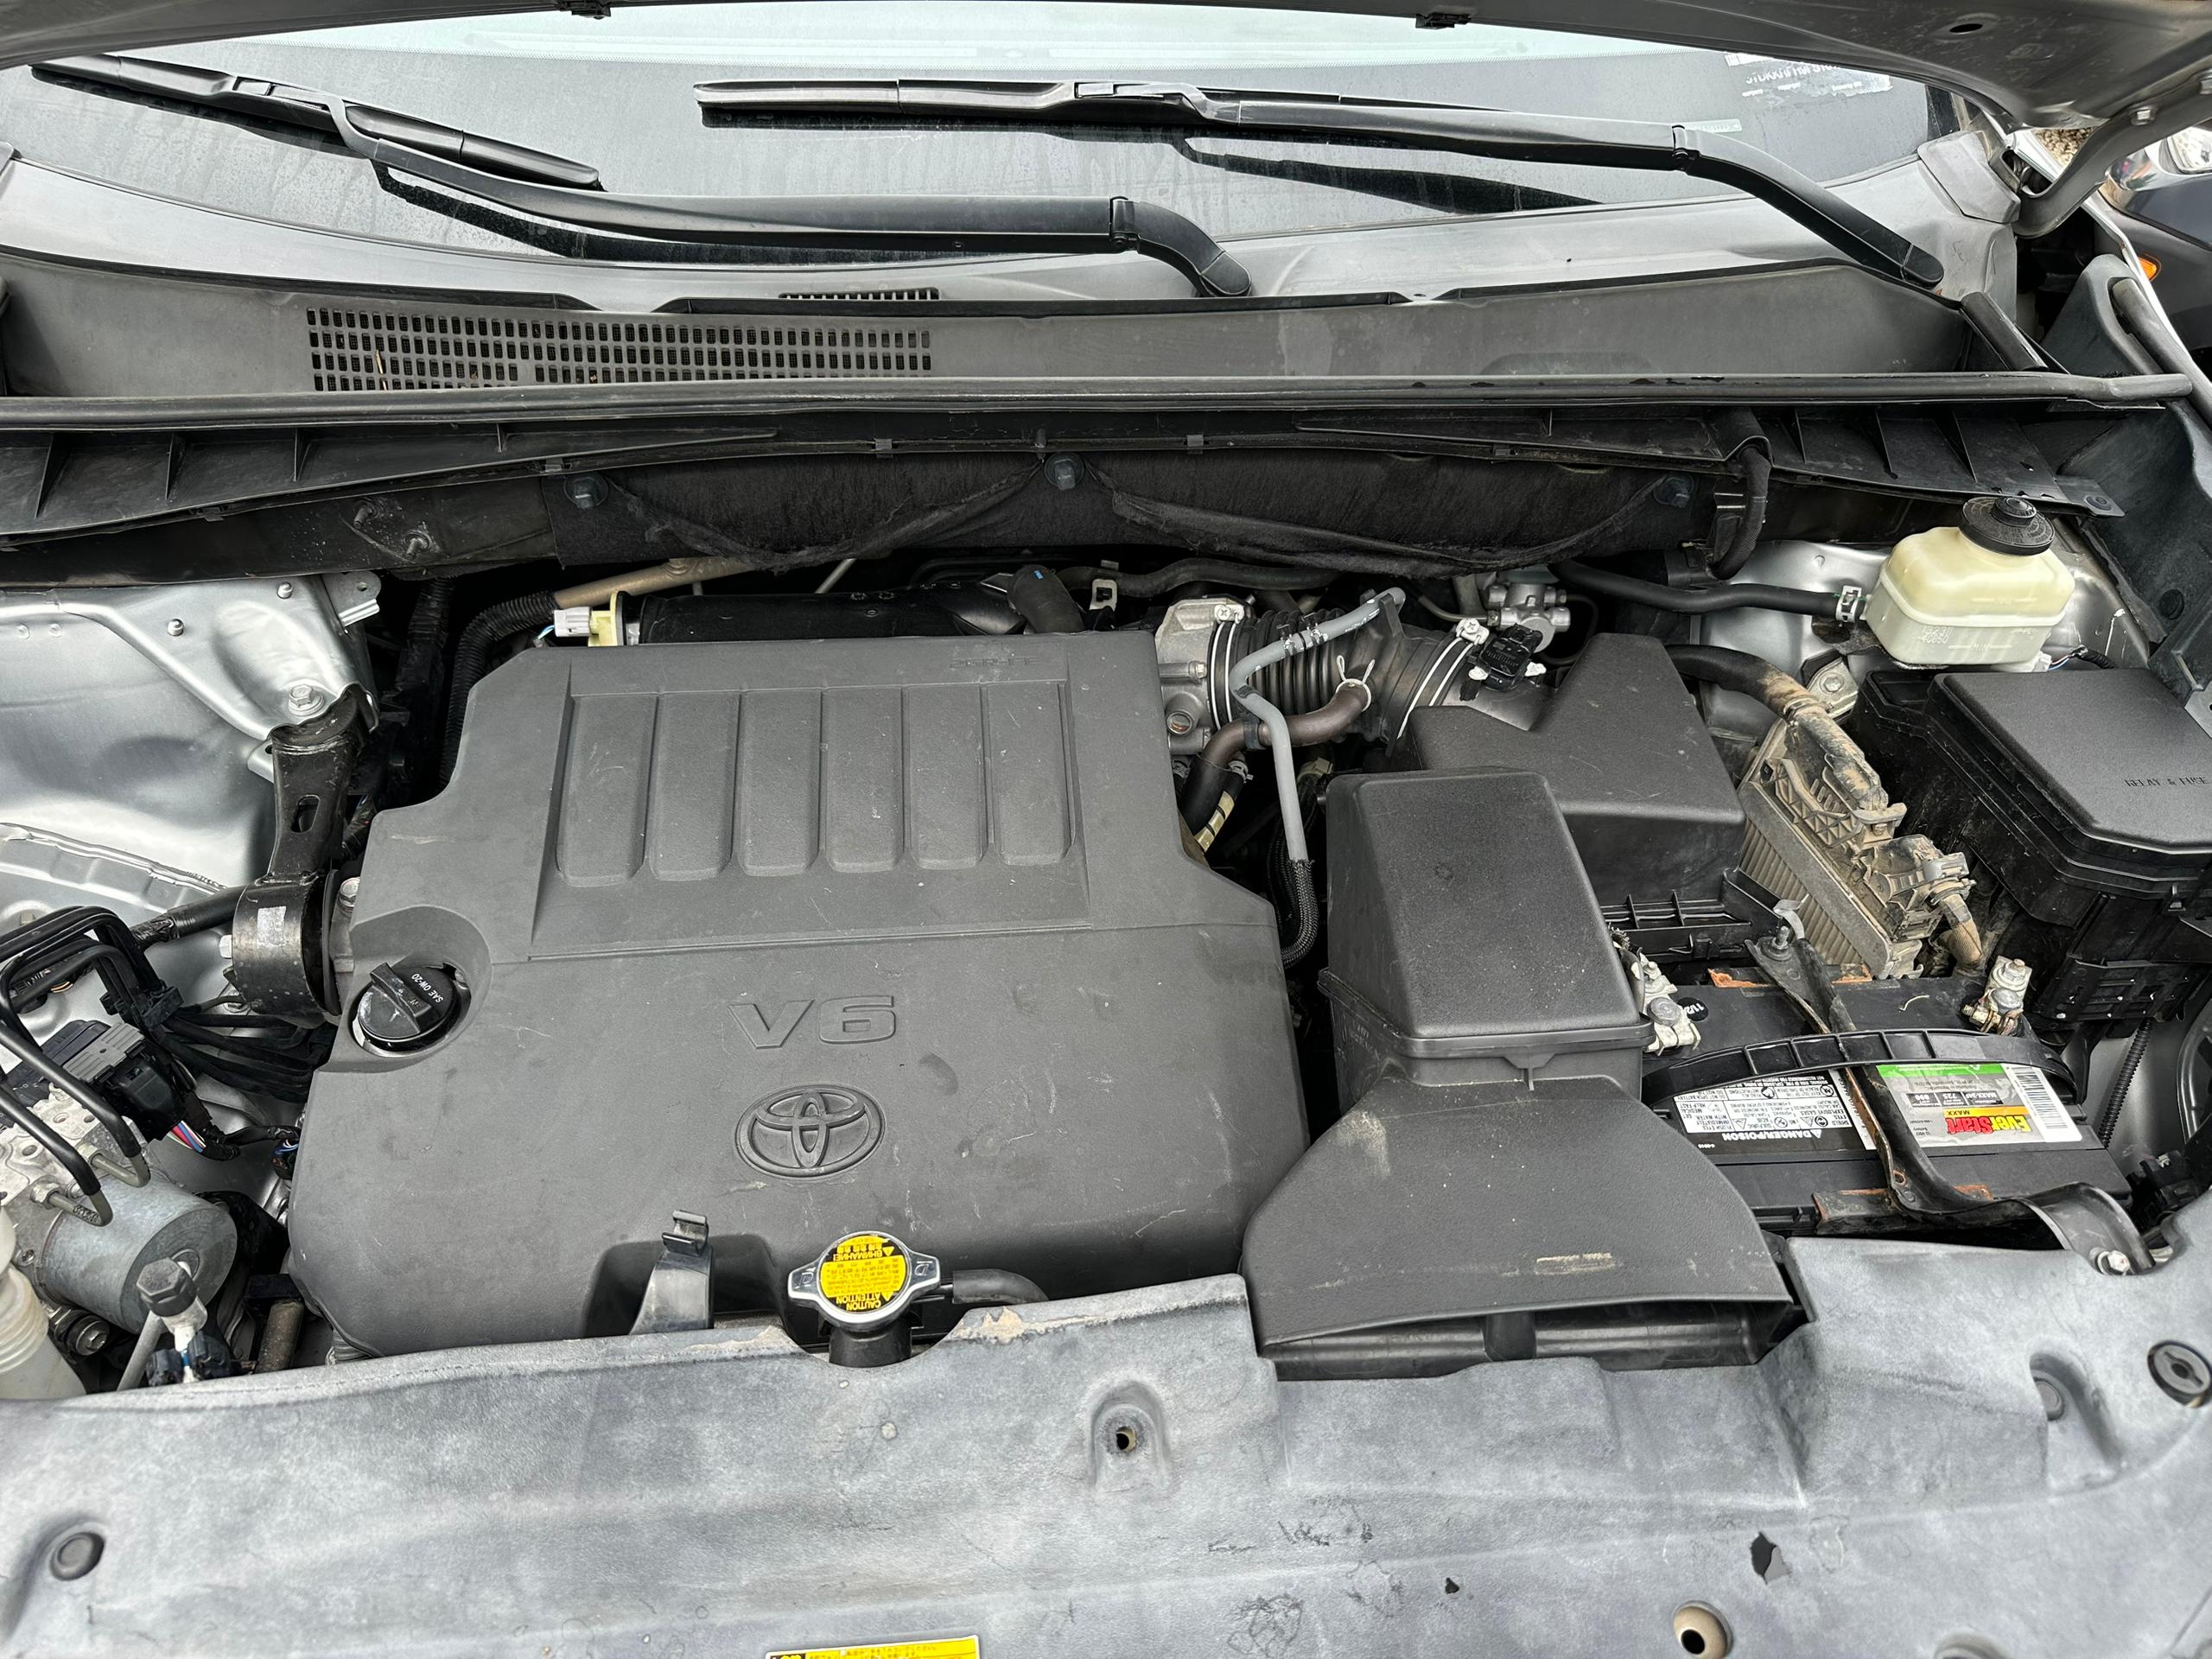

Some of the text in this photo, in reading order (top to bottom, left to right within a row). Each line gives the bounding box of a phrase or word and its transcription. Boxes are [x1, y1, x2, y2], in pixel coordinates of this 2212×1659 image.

[428, 989, 444, 1003] SAE
[727, 995, 897, 1049] V6
[1944, 1115, 2032, 1135] EverStart
[1721, 1129, 1811, 1141] DANGER/POISON
[833, 1250, 882, 1261] ВНИМАНИЕ!
[836, 1292, 880, 1304] ATTENTION
[846, 1300, 881, 1310] CAUTION
